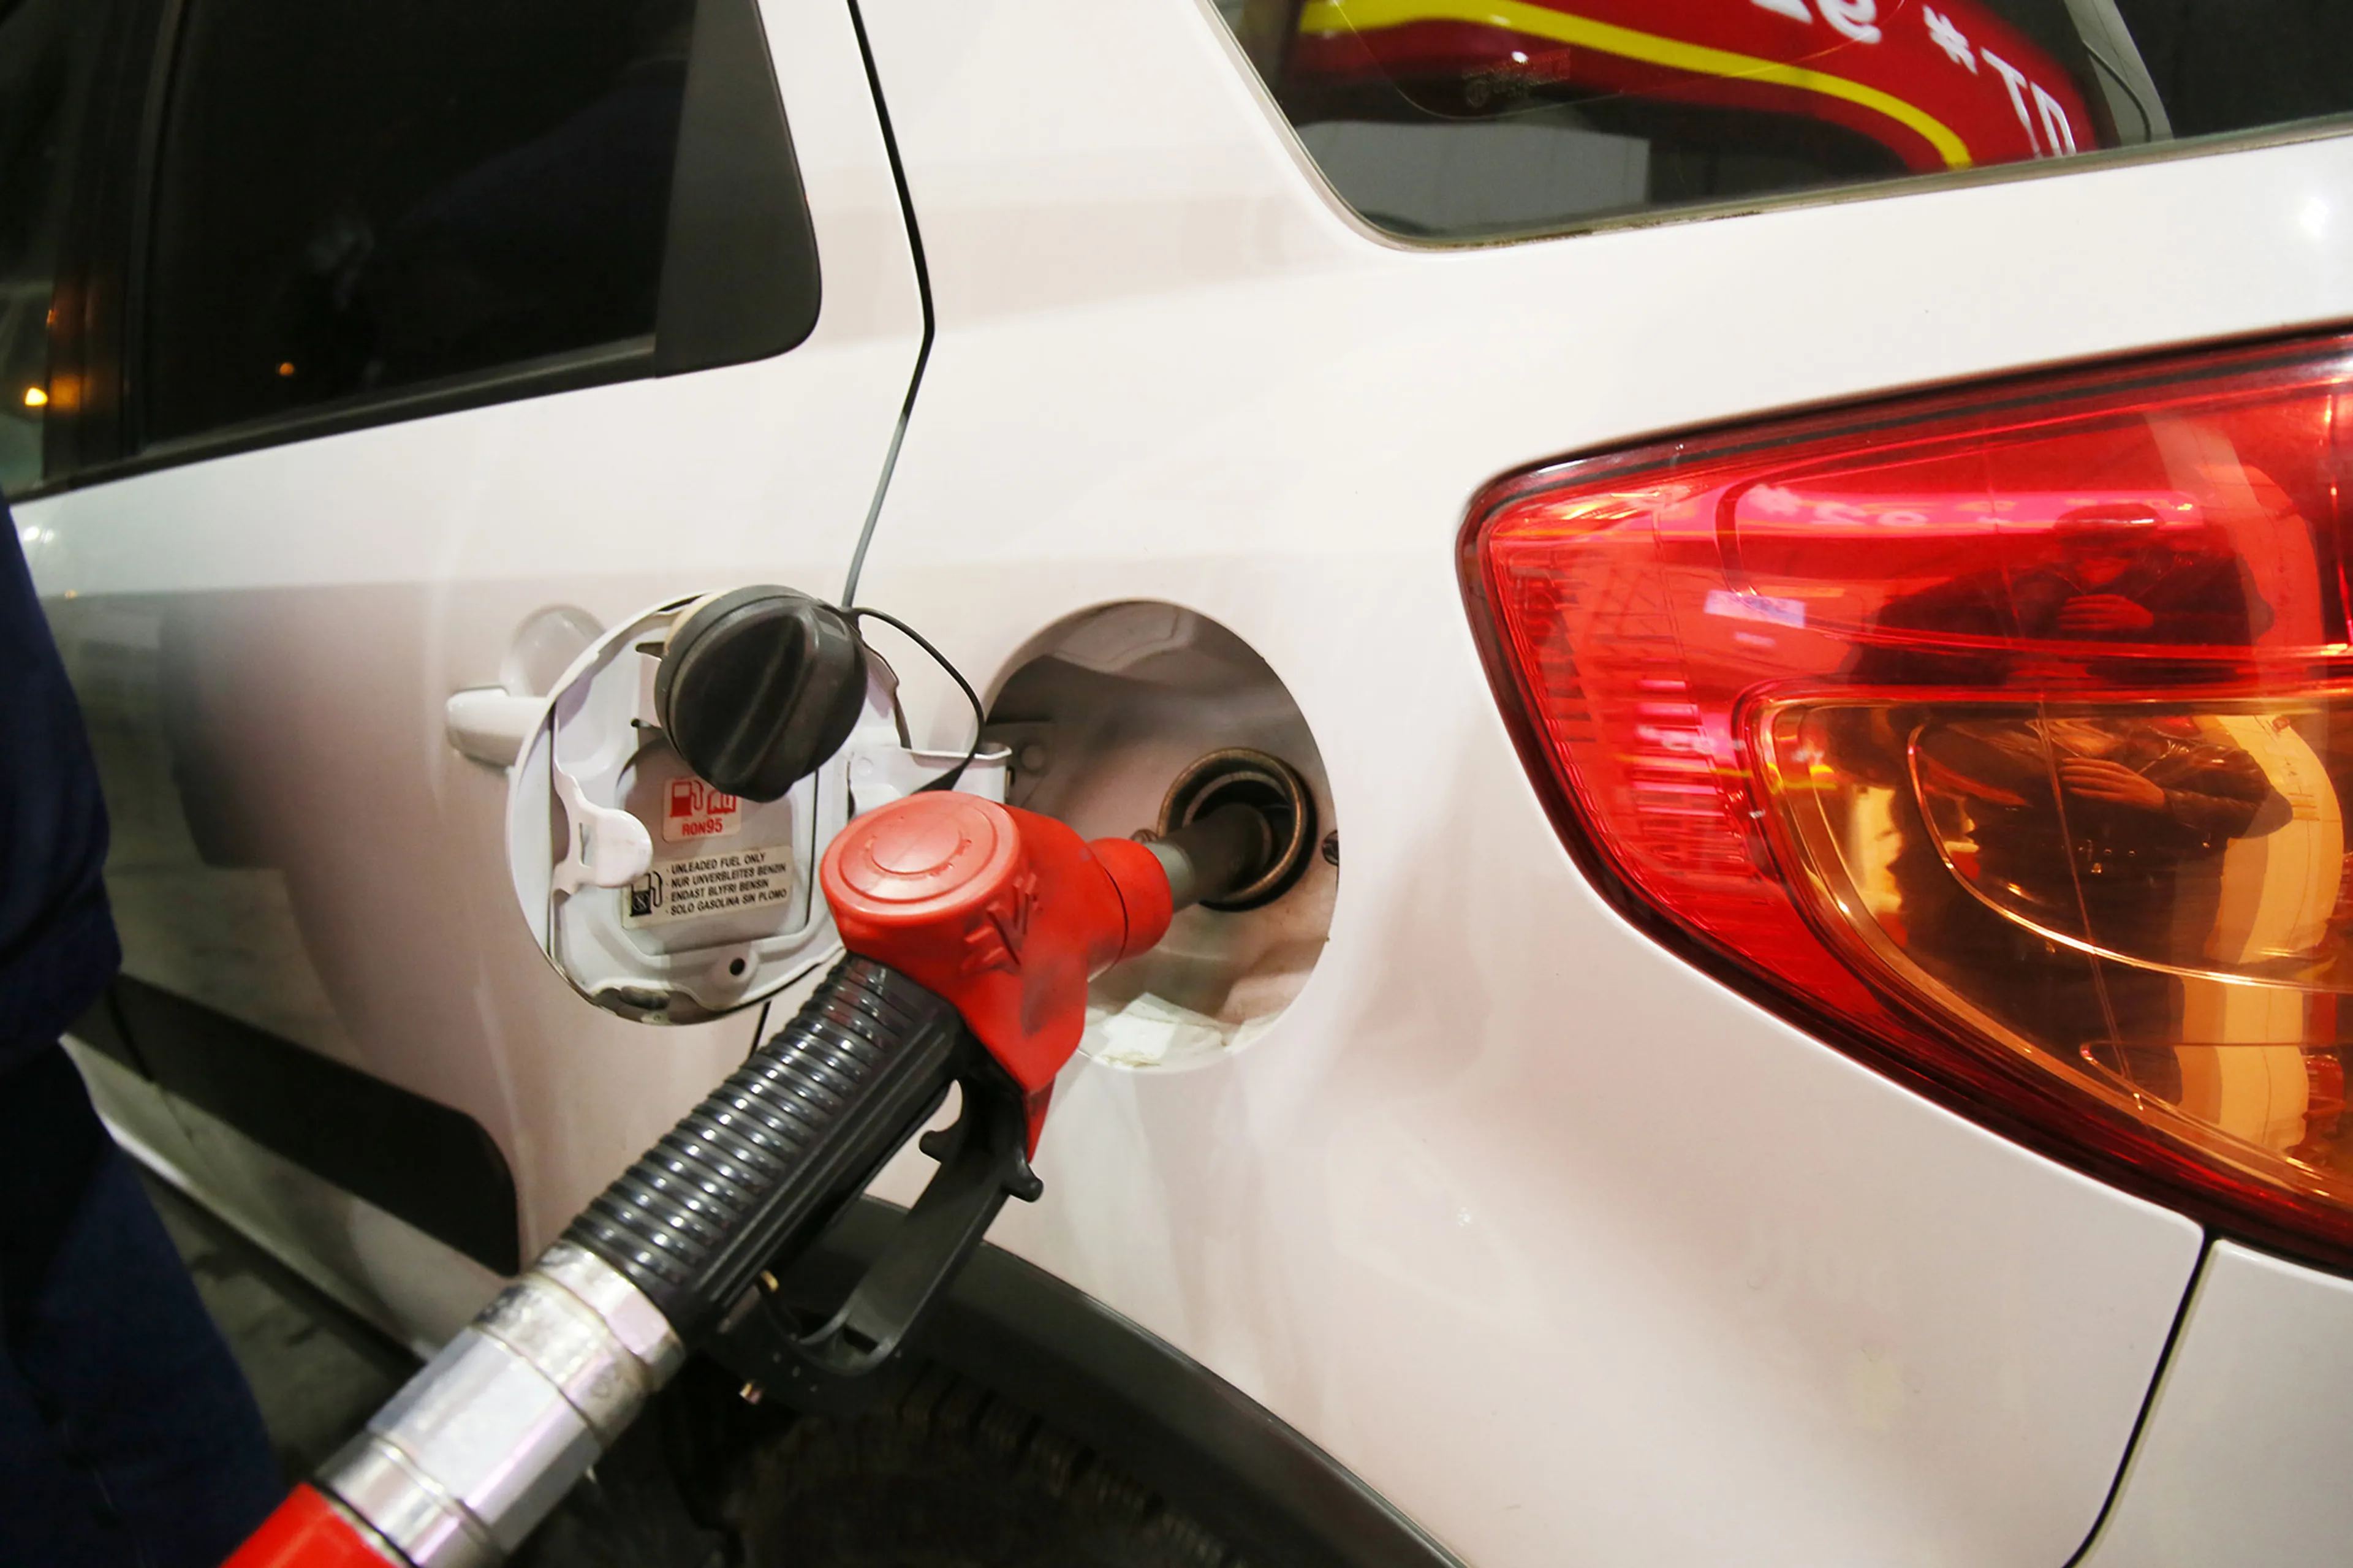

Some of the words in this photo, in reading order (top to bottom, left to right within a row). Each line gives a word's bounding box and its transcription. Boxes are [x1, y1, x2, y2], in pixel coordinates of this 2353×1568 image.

[682, 818, 723, 836] RON95
[671, 860, 718, 874] UNLEADED
[720, 856, 741, 869] FUEL
[745, 852, 766, 864] ONLY
[671, 876, 690, 888] NUR
[692, 868, 755, 885] UNVERBLEITES
[670, 903, 695, 916] SOLO
[697, 896, 740, 911] GASOLINA
[742, 893, 756, 904] SIN
[758, 888, 787, 902] PLOMO
[671, 887, 705, 902] ENDAST
